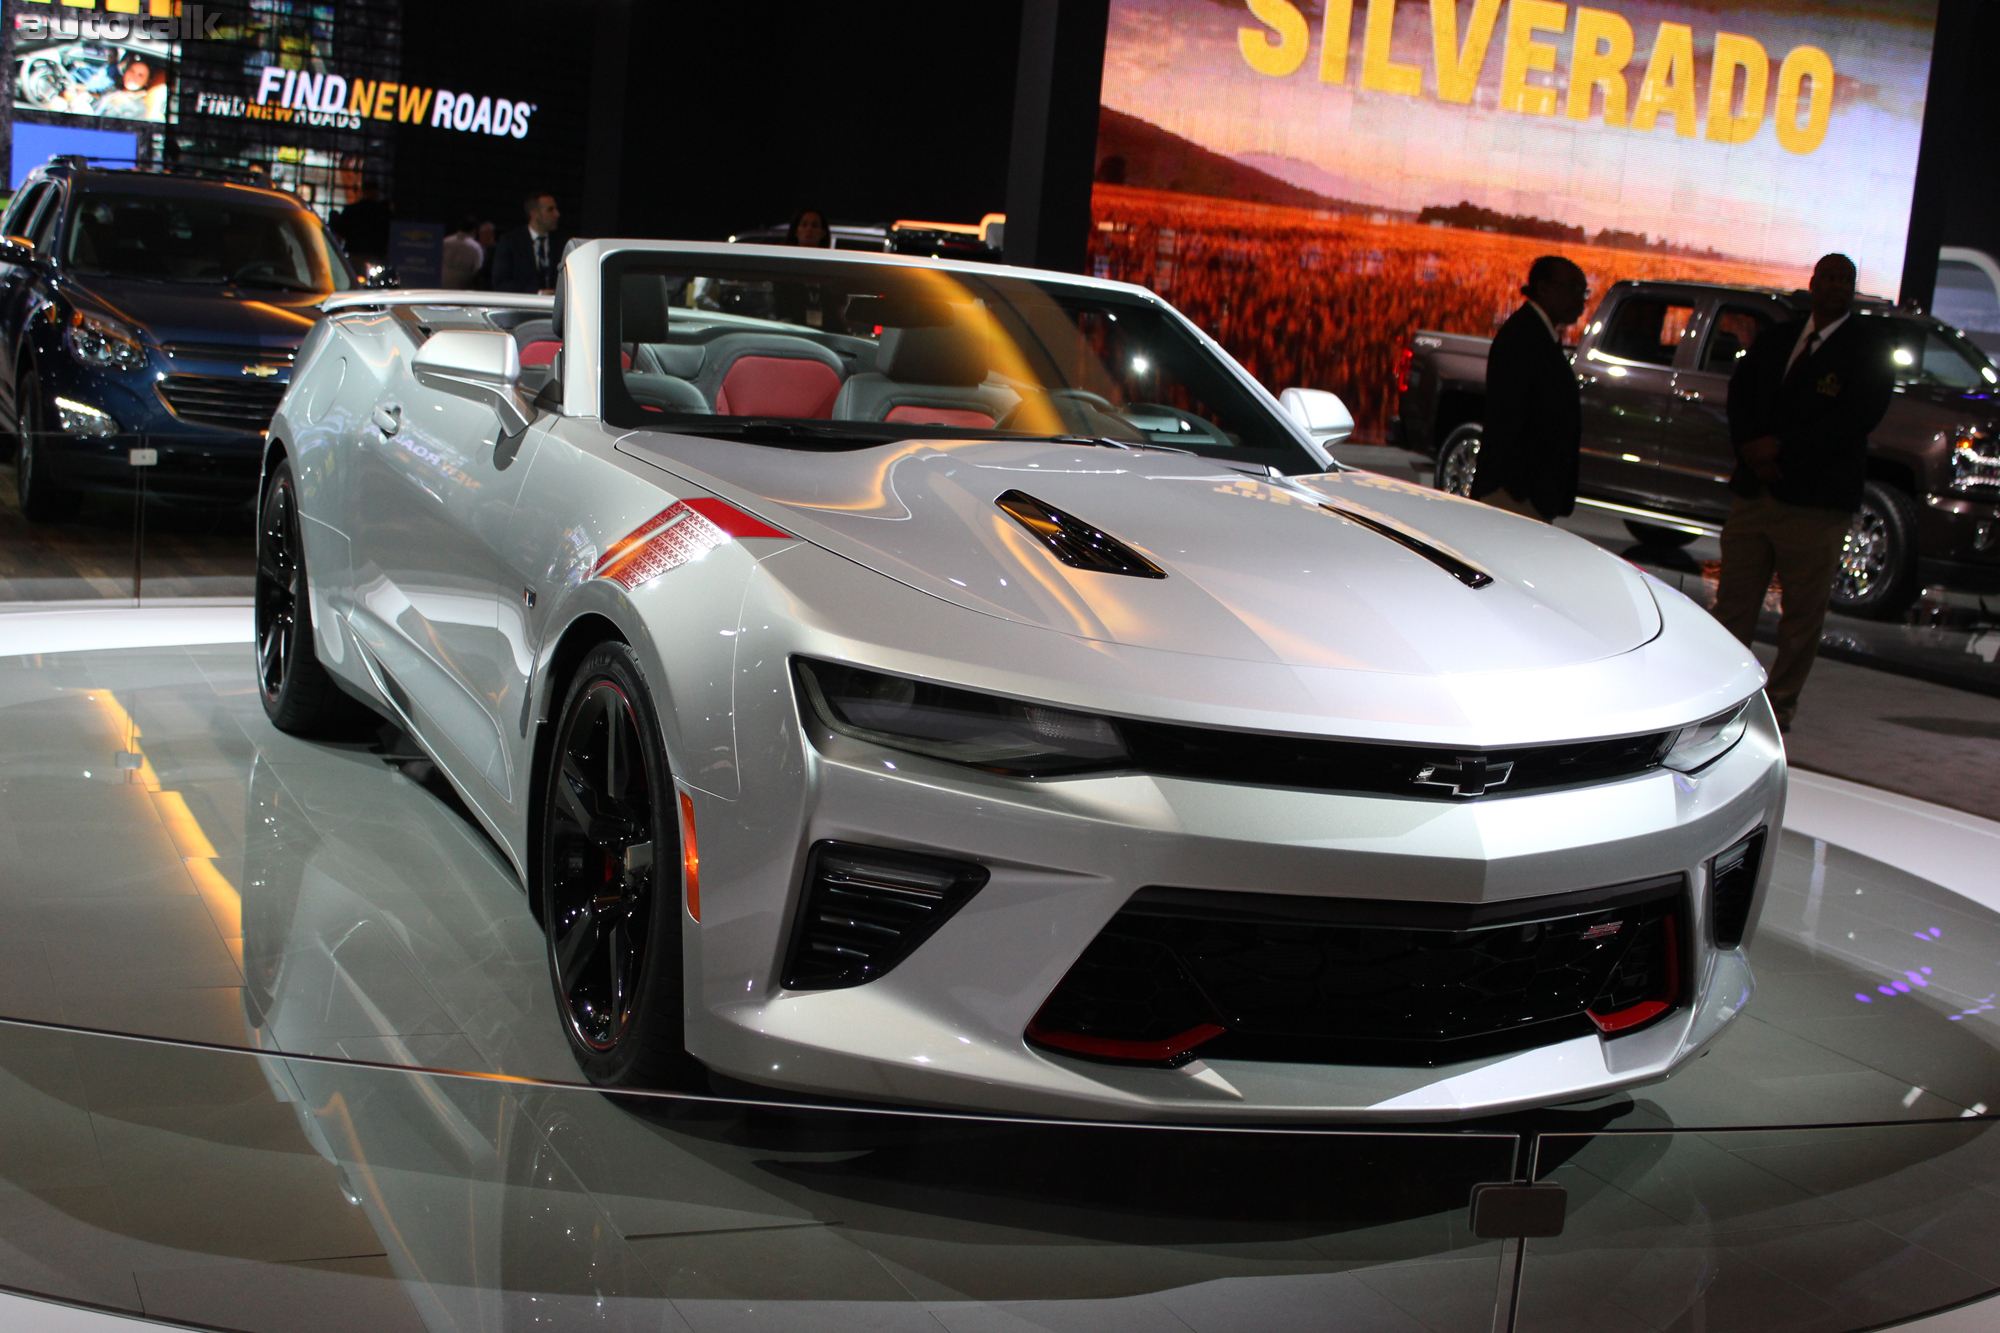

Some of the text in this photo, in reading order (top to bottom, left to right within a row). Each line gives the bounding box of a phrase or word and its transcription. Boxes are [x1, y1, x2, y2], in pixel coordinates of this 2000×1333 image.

[195, 92, 246, 117] FIND
[257, 66, 347, 115] FIND
[349, 78, 433, 125] NEW
[1237, 0, 1835, 155] SILVERADO
